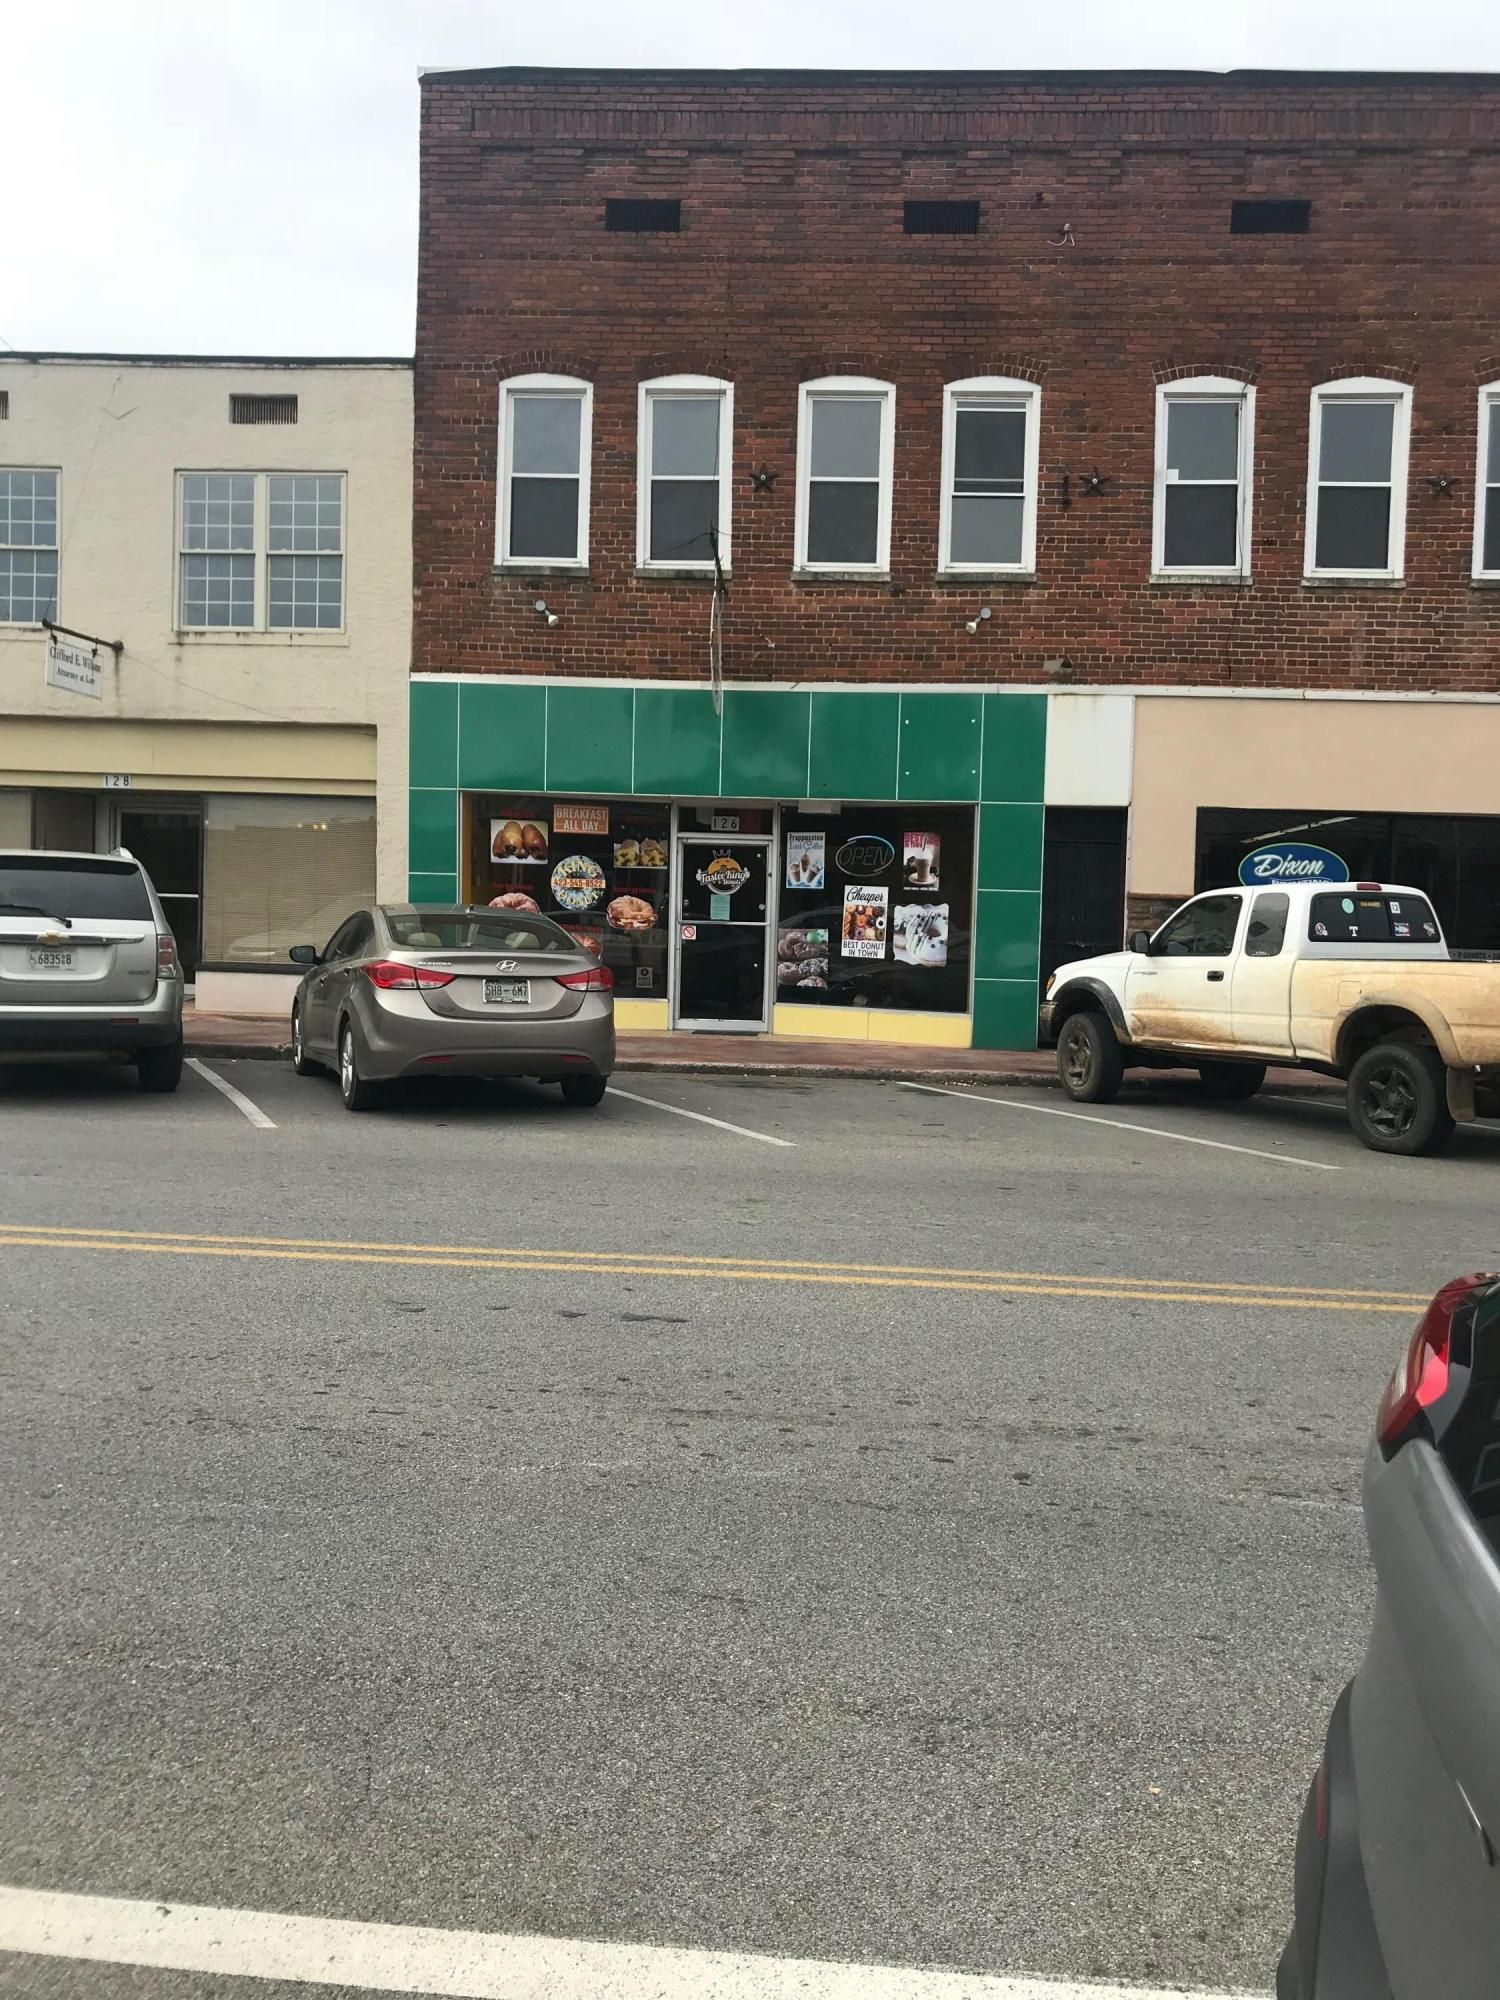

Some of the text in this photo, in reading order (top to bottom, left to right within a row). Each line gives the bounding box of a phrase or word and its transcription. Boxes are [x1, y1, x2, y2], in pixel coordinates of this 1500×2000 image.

[50, 646, 74, 665] Clifford
[105, 775, 129, 787] 128
[556, 807, 607, 821] BREAKFAST
[564, 820, 599, 831] ALL DAY
[713, 817, 737, 829] 126
[789, 833, 824, 843] Frappuccino
[839, 846, 890, 866] OPEN
[556, 859, 601, 878] KING
[1253, 853, 1325, 877] Dixon
[725, 867, 747, 882] King
[846, 886, 884, 904] Cheaper
[843, 940, 885, 951] BEST DONUT
[848, 948, 878, 958] IN TOWN
